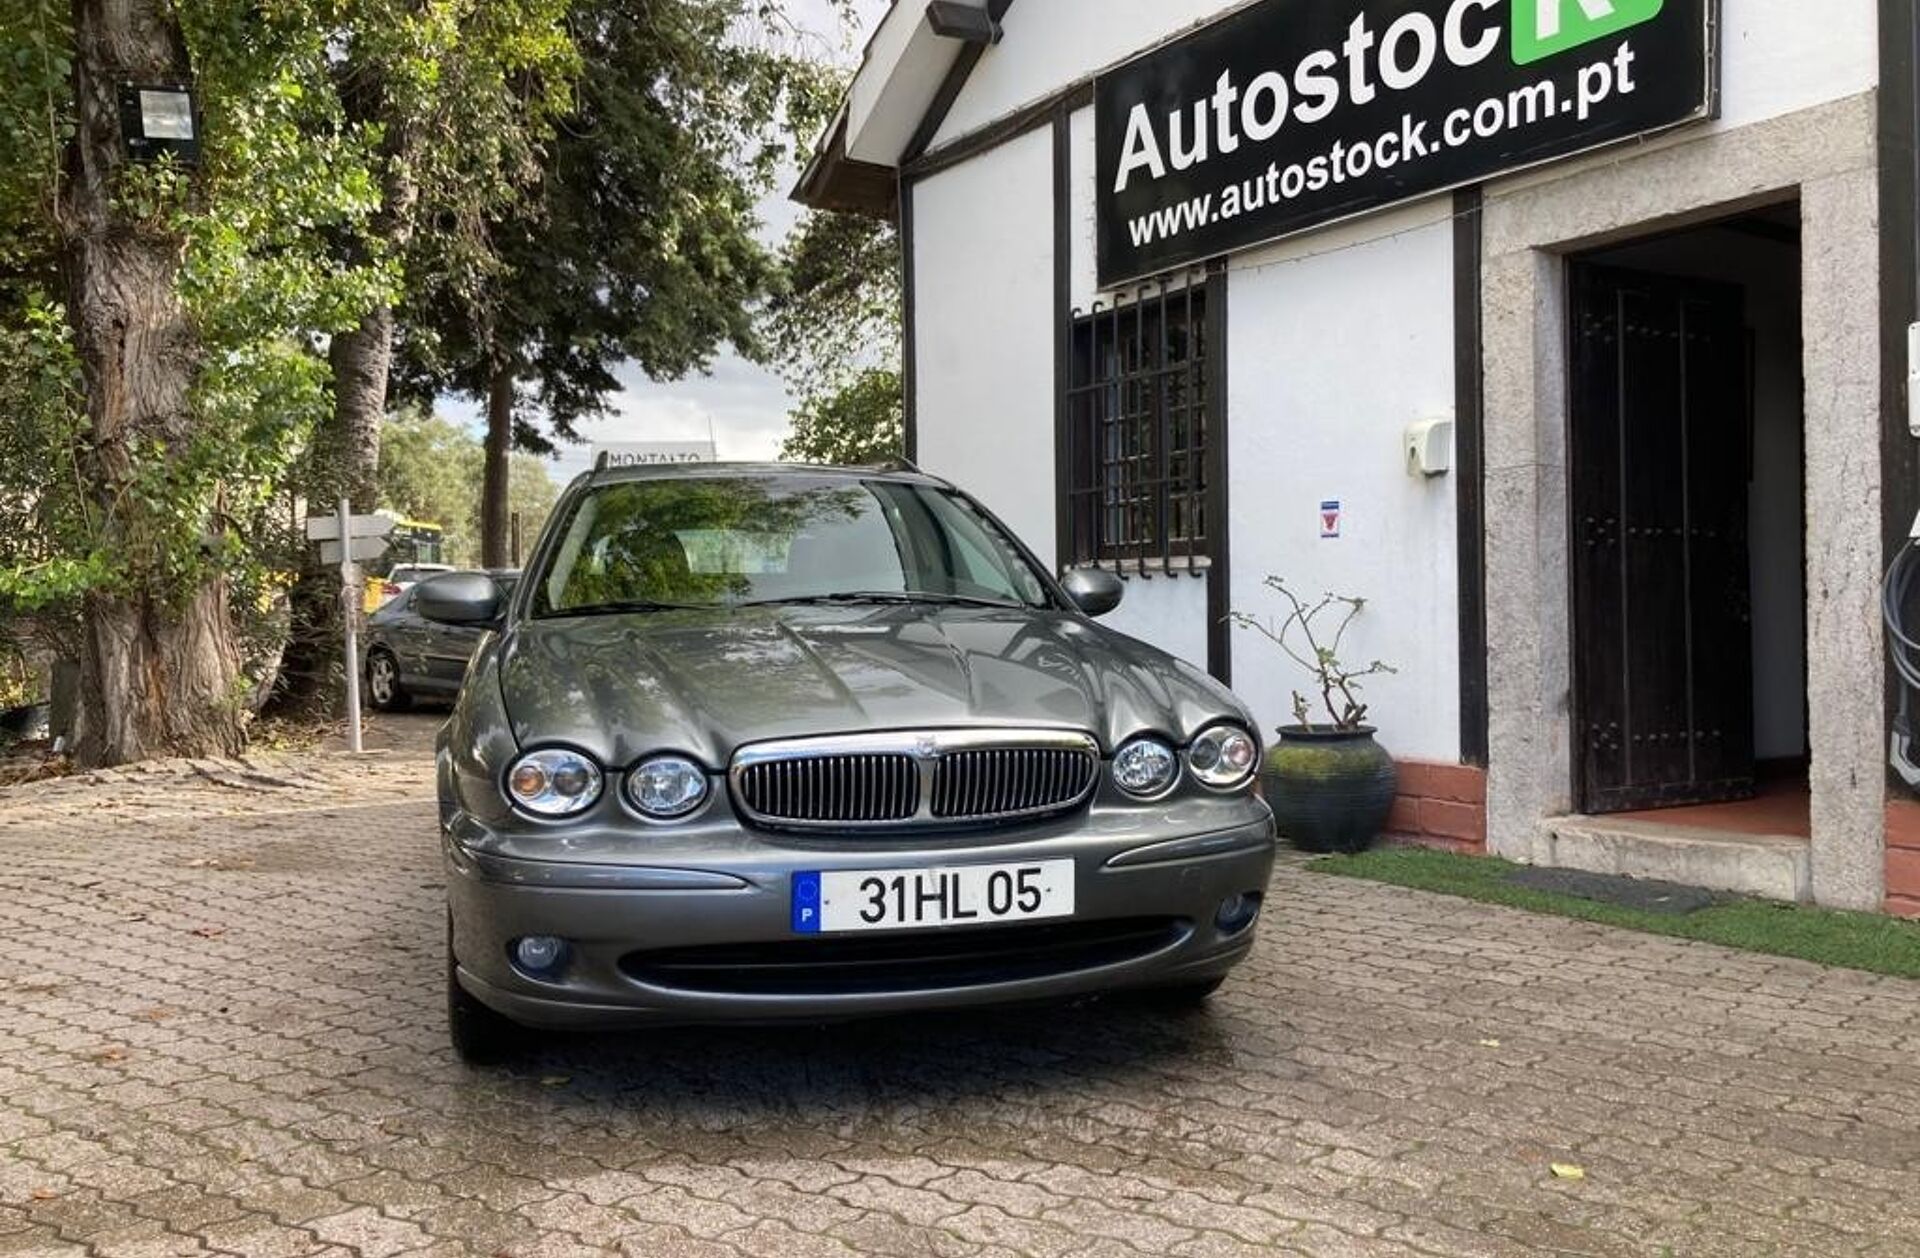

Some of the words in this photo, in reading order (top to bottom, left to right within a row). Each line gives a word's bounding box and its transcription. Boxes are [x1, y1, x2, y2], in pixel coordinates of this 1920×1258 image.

[1128, 40, 1635, 247] www.autostock.com.pt
[802, 908, 813, 922] P
[987, 867, 1042, 916] 05
